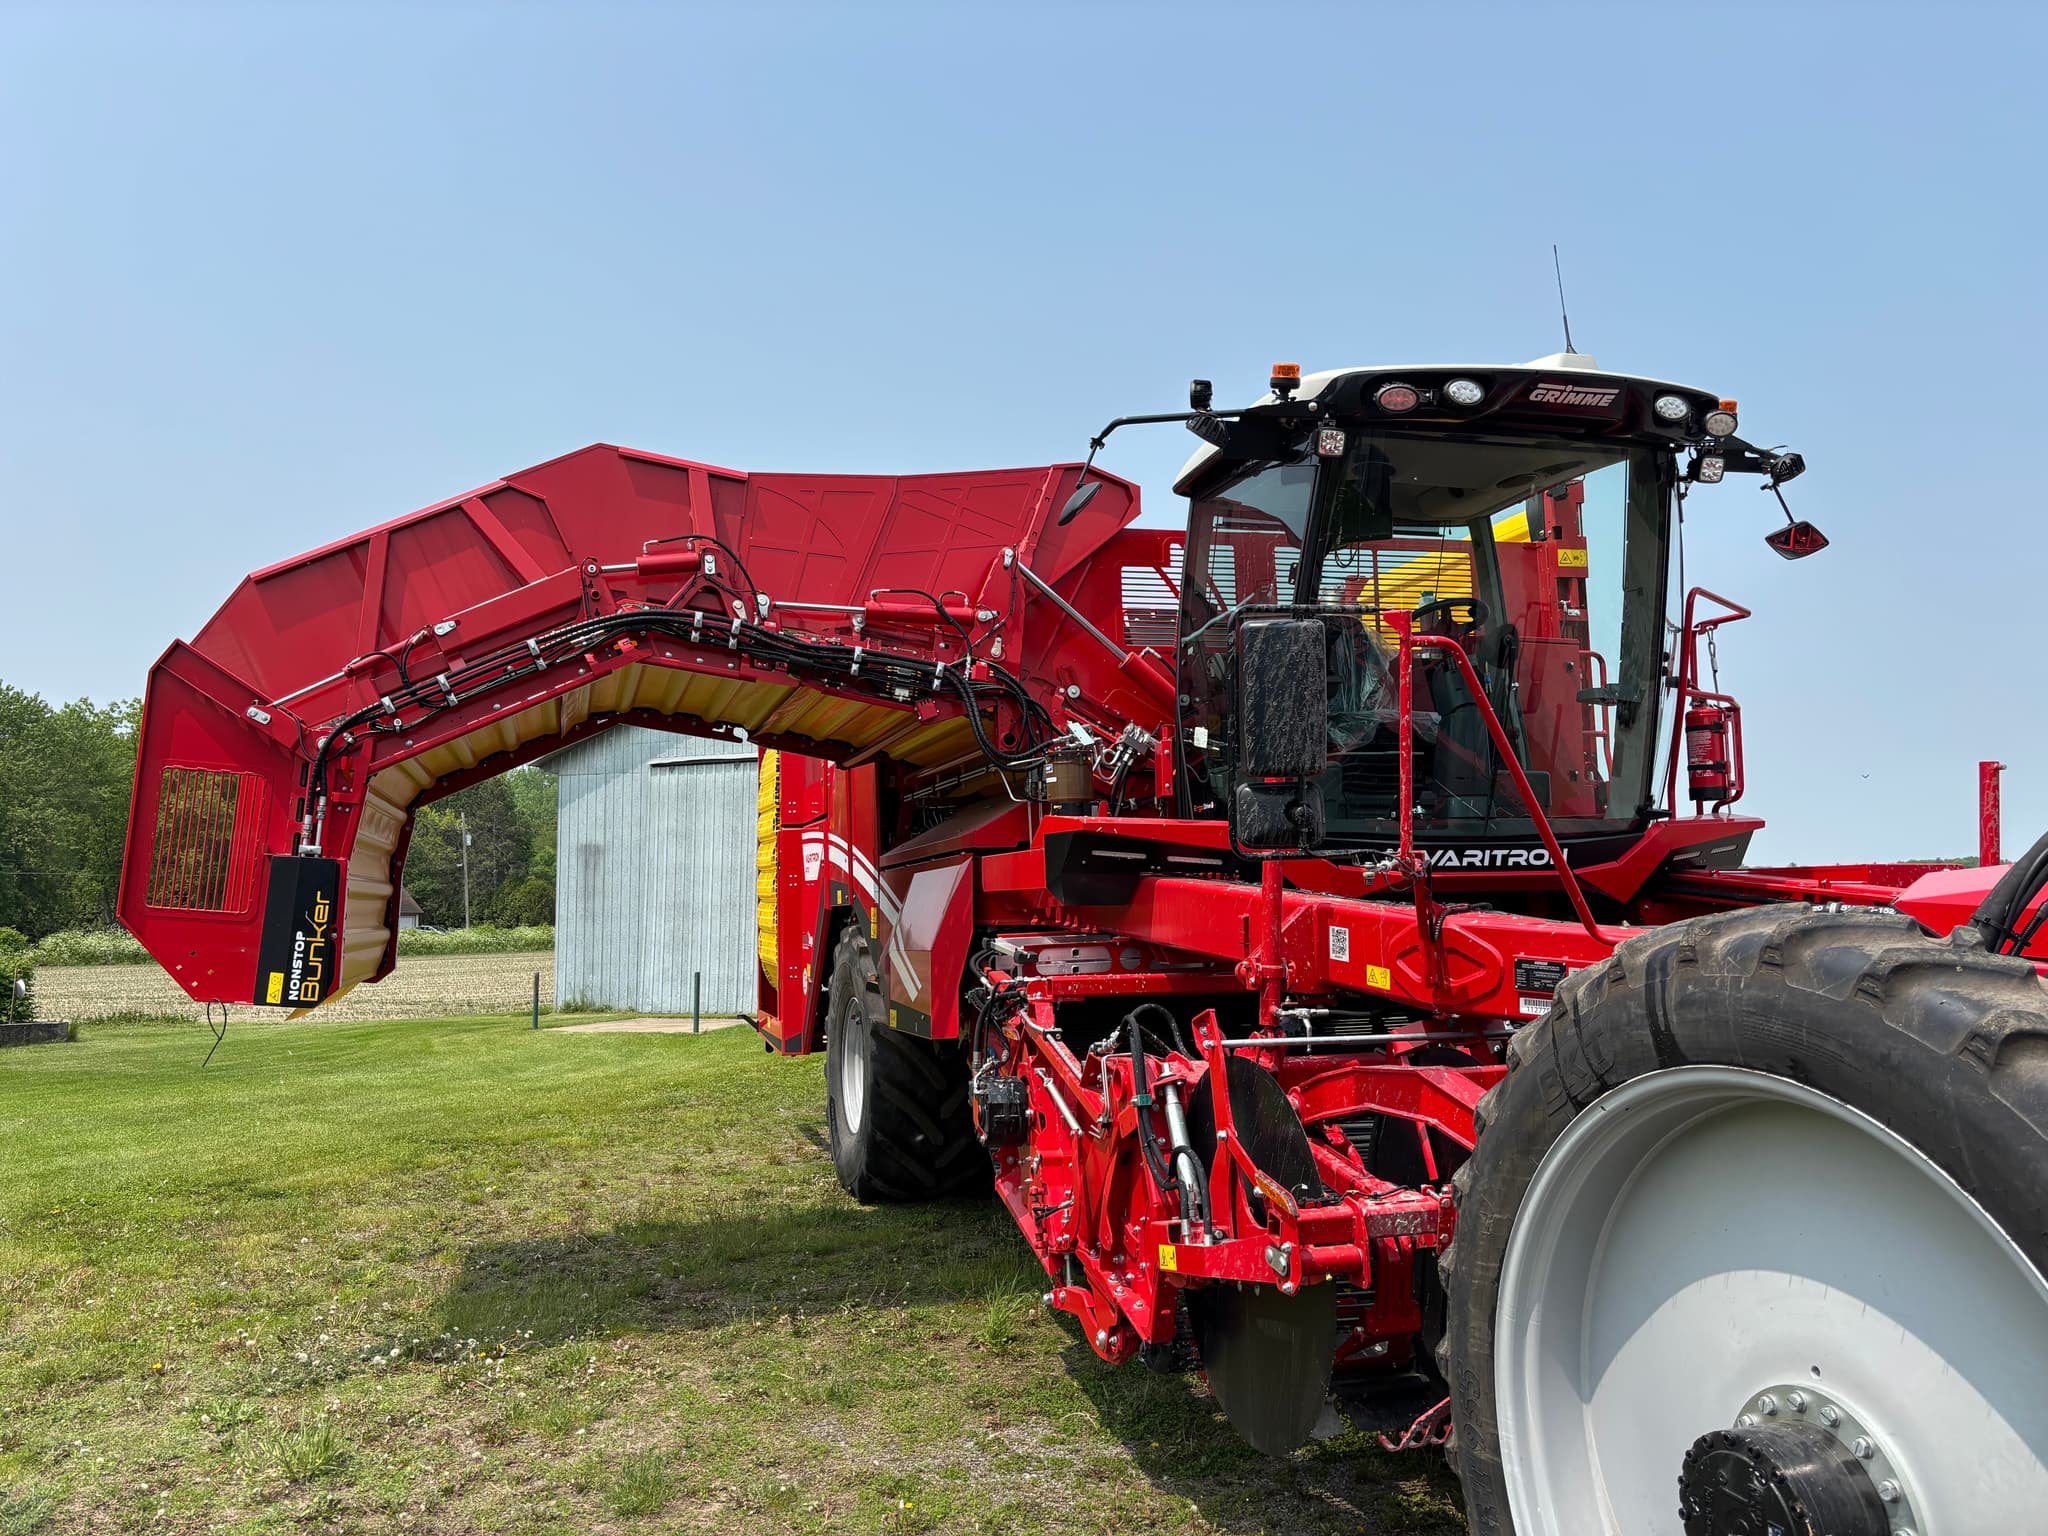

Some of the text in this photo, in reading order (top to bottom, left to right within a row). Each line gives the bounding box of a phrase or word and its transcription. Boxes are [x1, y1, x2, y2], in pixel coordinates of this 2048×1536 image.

[1528, 385, 1617, 407] GRIMME
[288, 930, 306, 1000] NONSTOP
[299, 890, 330, 1002] Bunker
